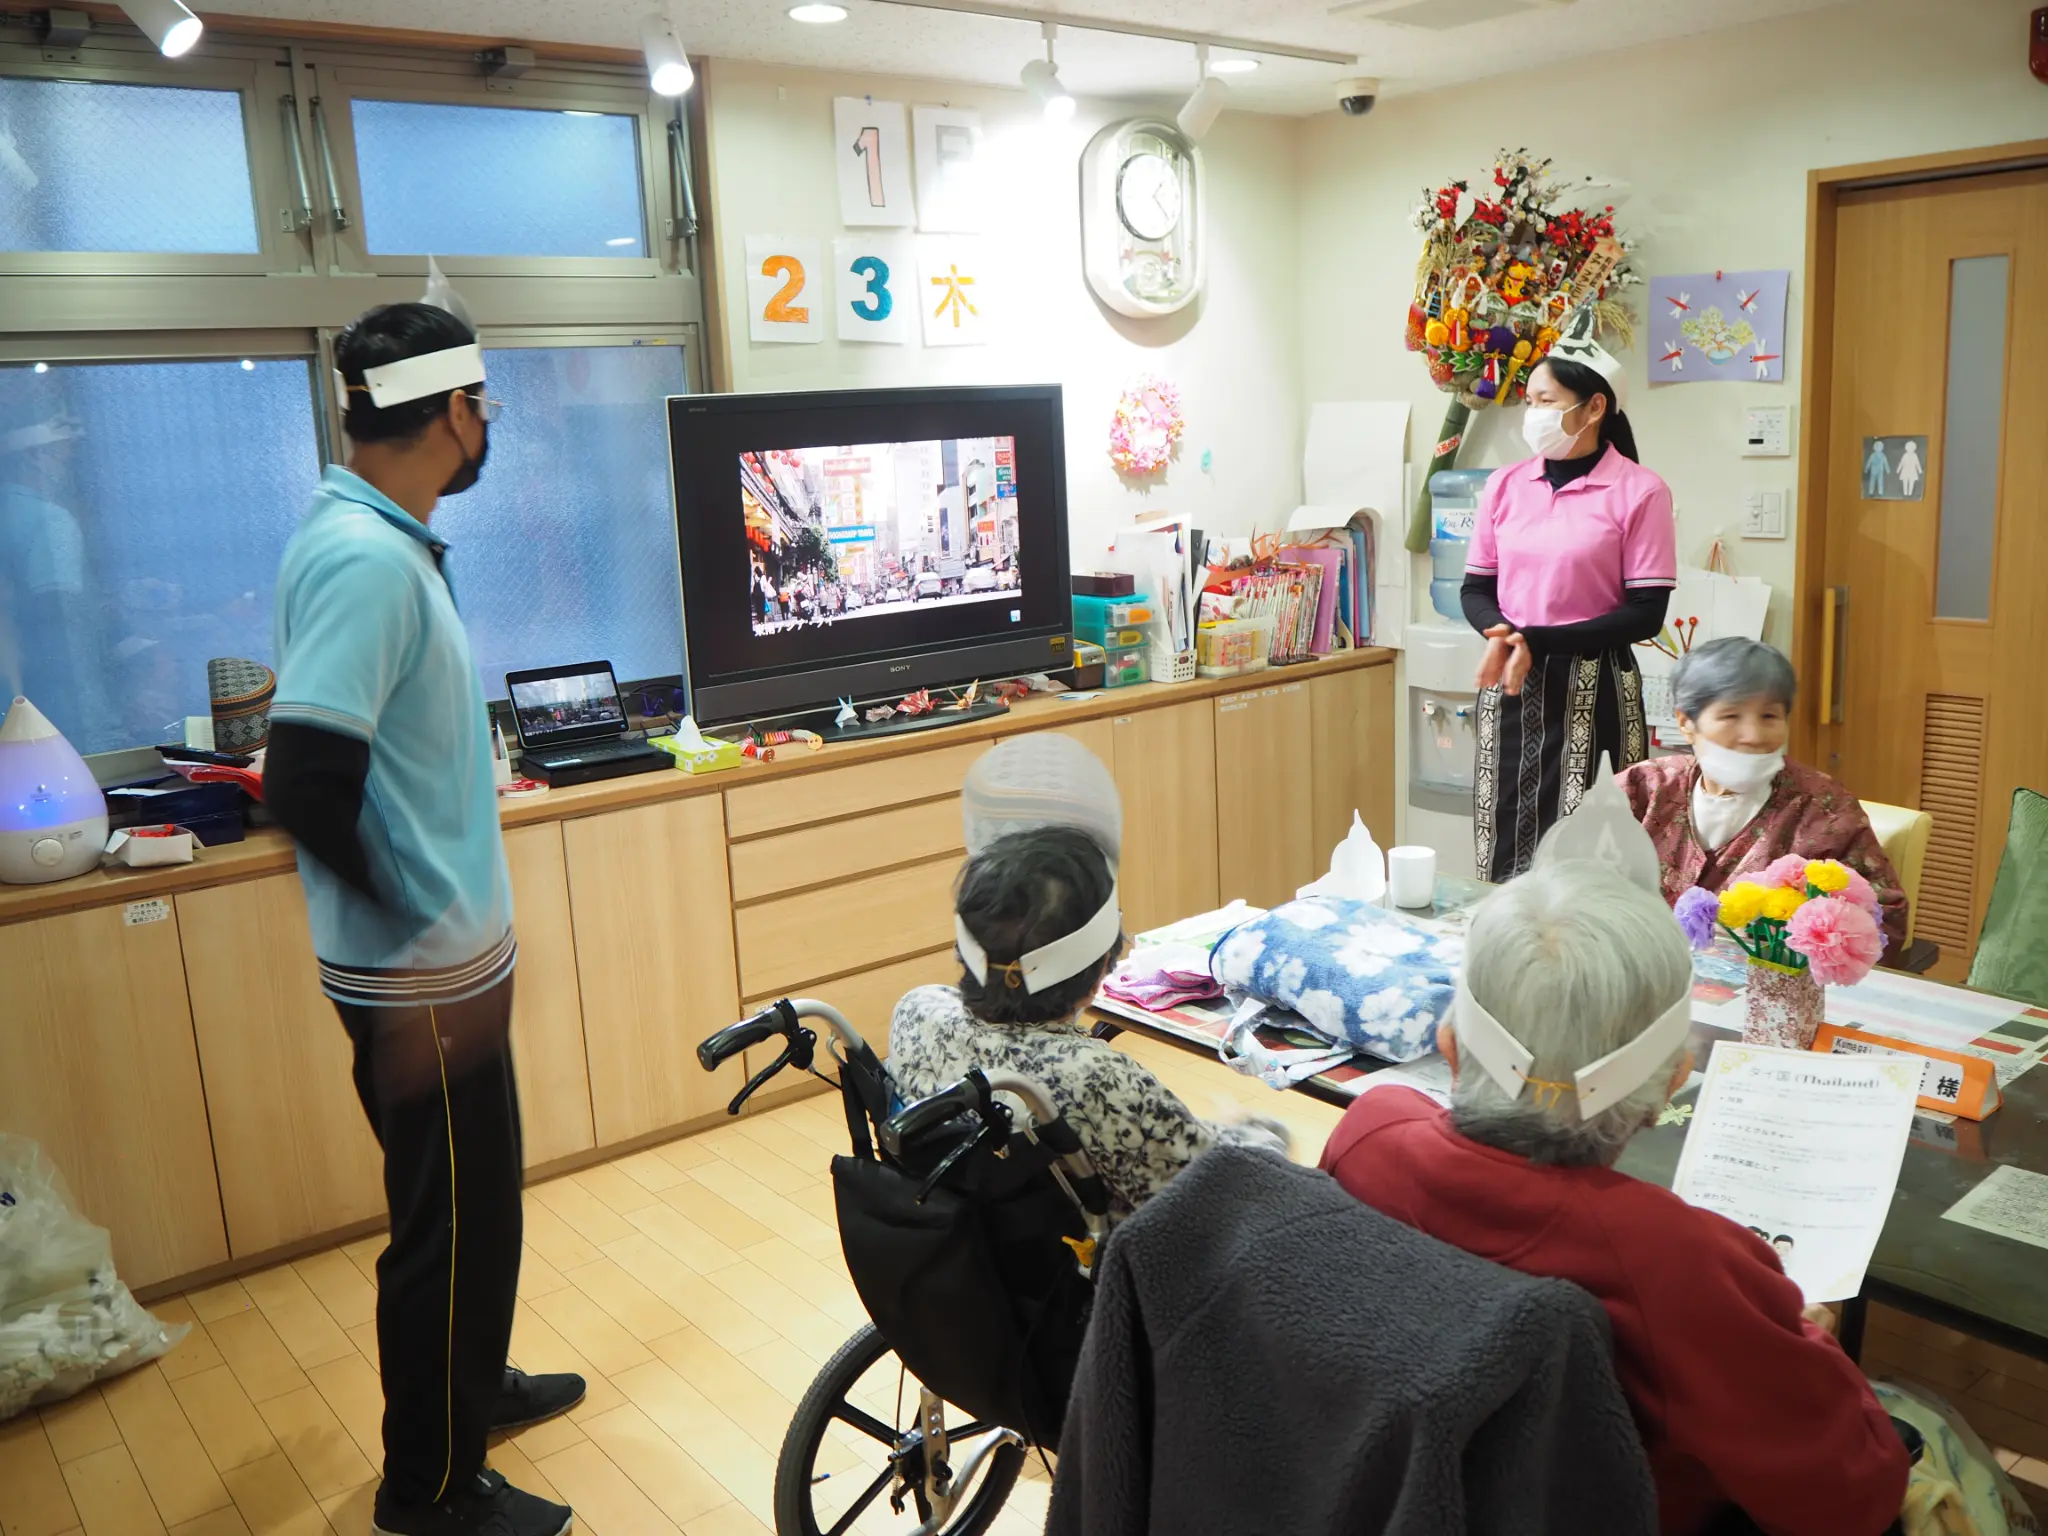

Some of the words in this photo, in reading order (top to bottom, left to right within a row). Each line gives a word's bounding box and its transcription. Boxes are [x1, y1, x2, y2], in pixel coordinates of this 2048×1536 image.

[852, 127, 886, 208] 1
[761, 254, 809, 324] 2
[850, 256, 893, 322] 3
[930, 263, 979, 328] 木
[890, 664, 911, 673] SONY
[1835, 1037, 1873, 1054] Kumagai
[1750, 1066, 1790, 1082] タイ国
[1795, 1073, 1880, 1089] (Thailand)
[1936, 1075, 1960, 1099] 様
